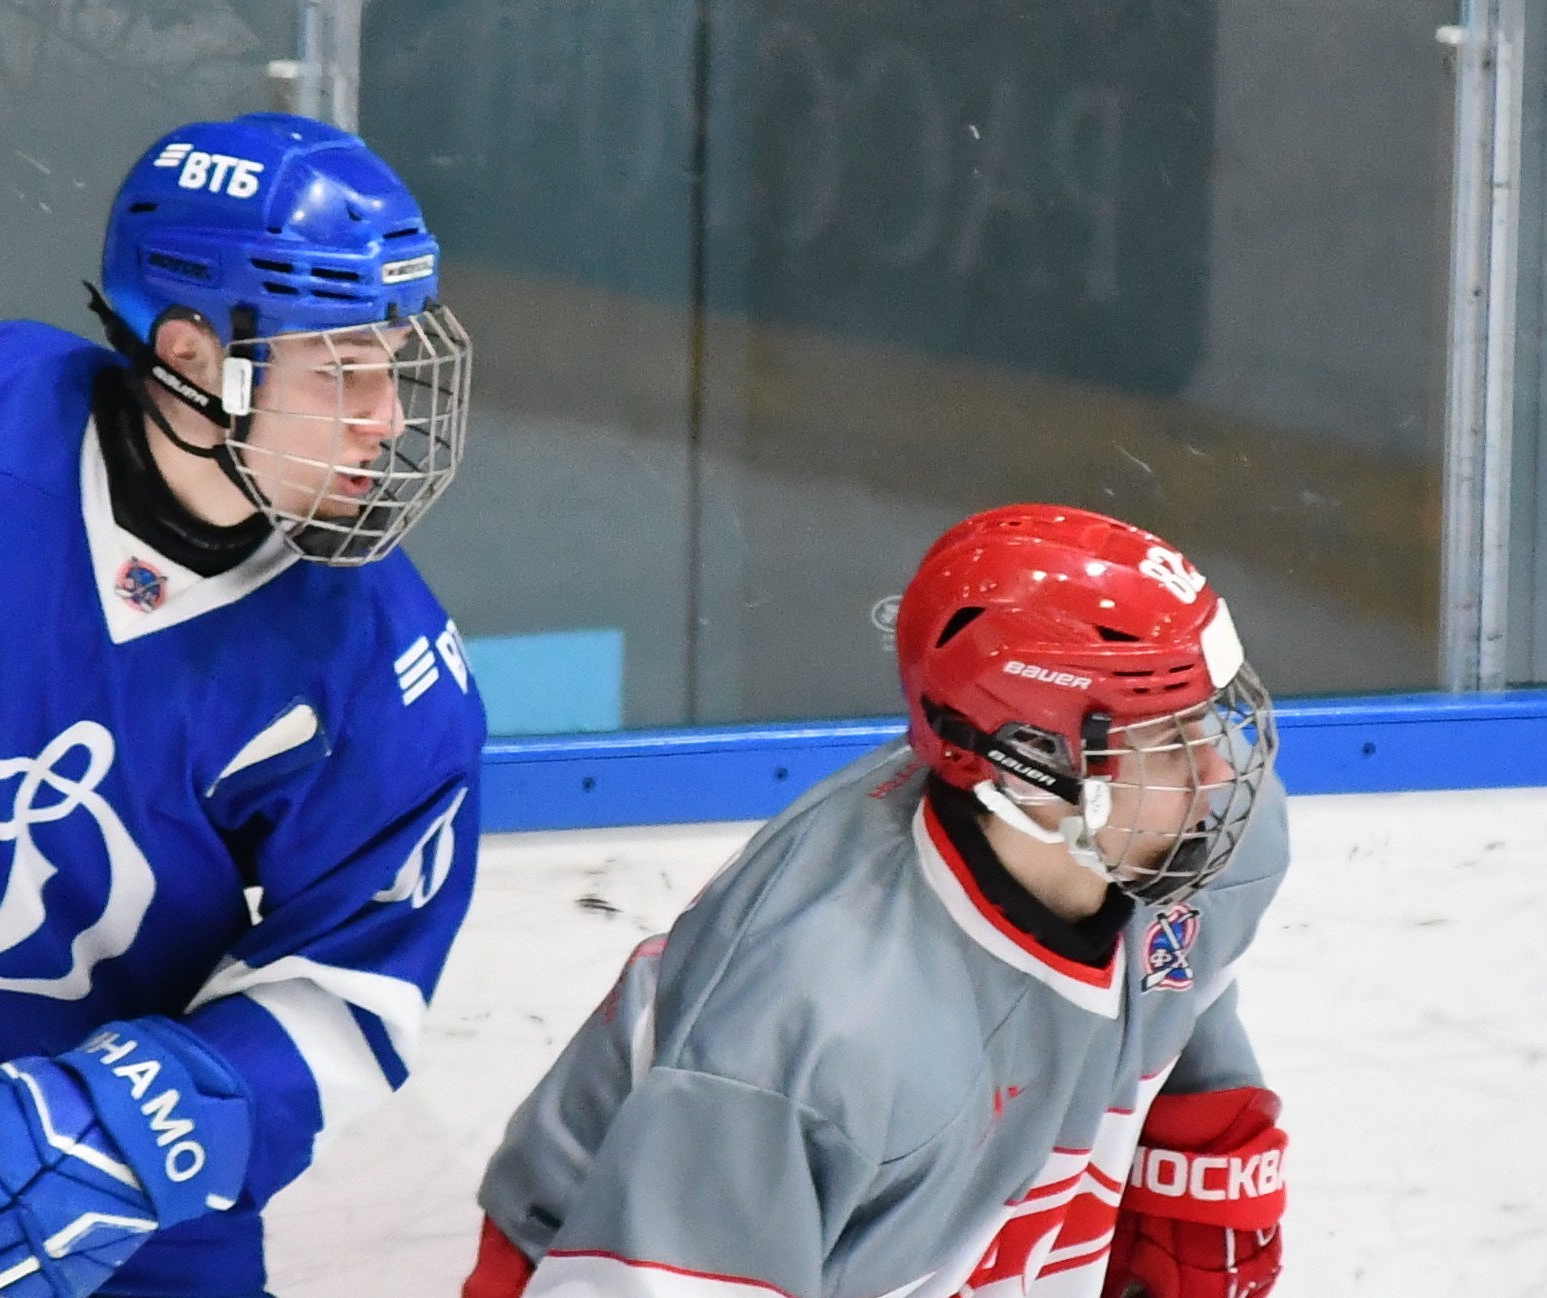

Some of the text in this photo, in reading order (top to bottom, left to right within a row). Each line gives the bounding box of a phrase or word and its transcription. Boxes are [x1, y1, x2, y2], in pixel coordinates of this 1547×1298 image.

[177, 151, 265, 199] ВТБ
[1138, 545, 1207, 605] 82
[1003, 660, 1093, 690] BAUER
[987, 749, 1057, 786] BAUER
